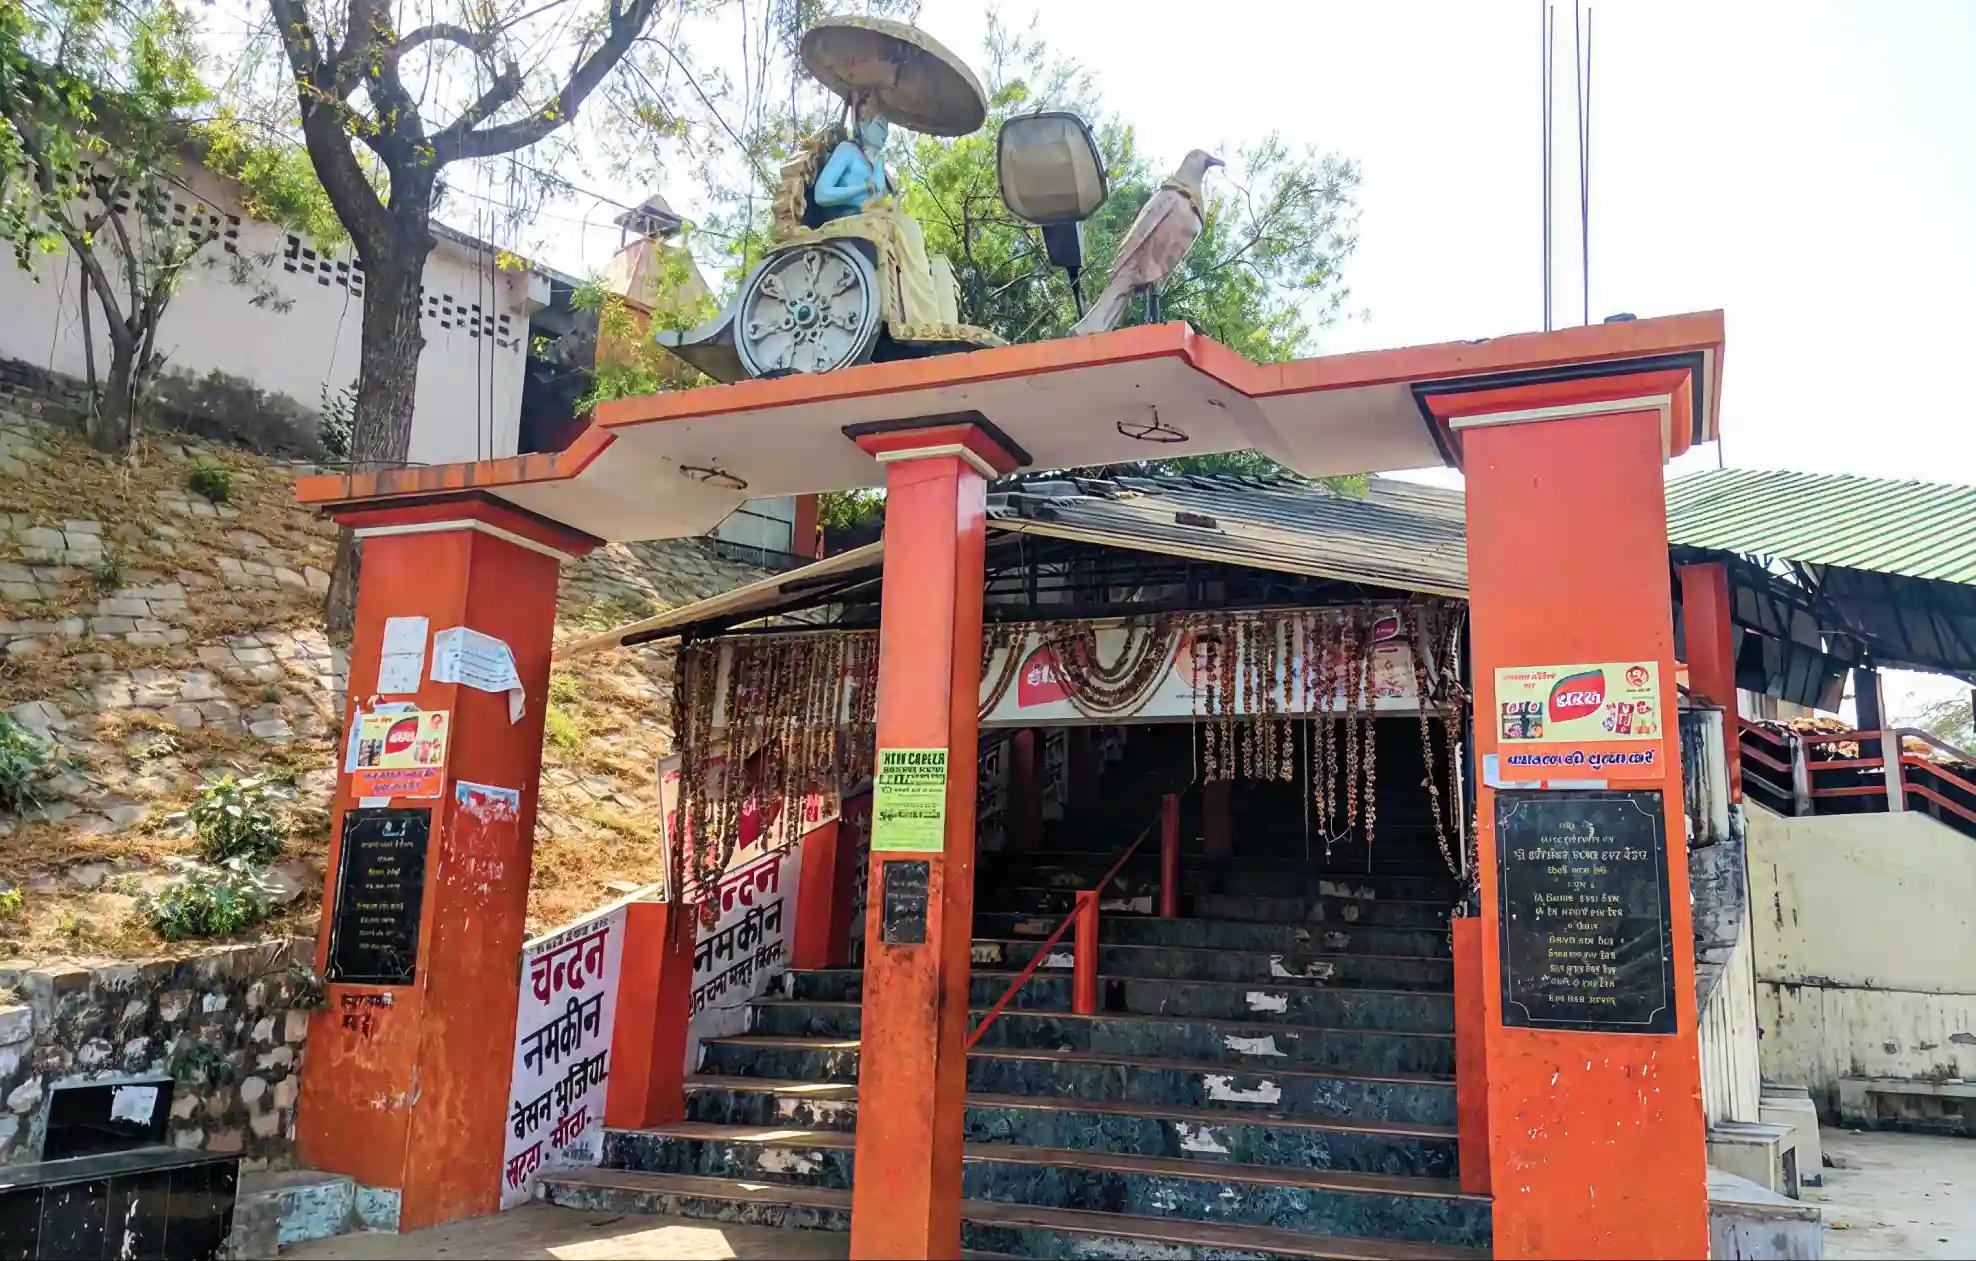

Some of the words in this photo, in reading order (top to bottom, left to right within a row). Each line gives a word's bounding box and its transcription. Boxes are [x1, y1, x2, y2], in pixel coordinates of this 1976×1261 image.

[530, 927, 610, 1006] चन्दन
[694, 898, 784, 972] नमकीन
[521, 990, 605, 1076] नमकीन
[511, 1089, 552, 1141] बेसन
[554, 1049, 609, 1114] भुजिया
